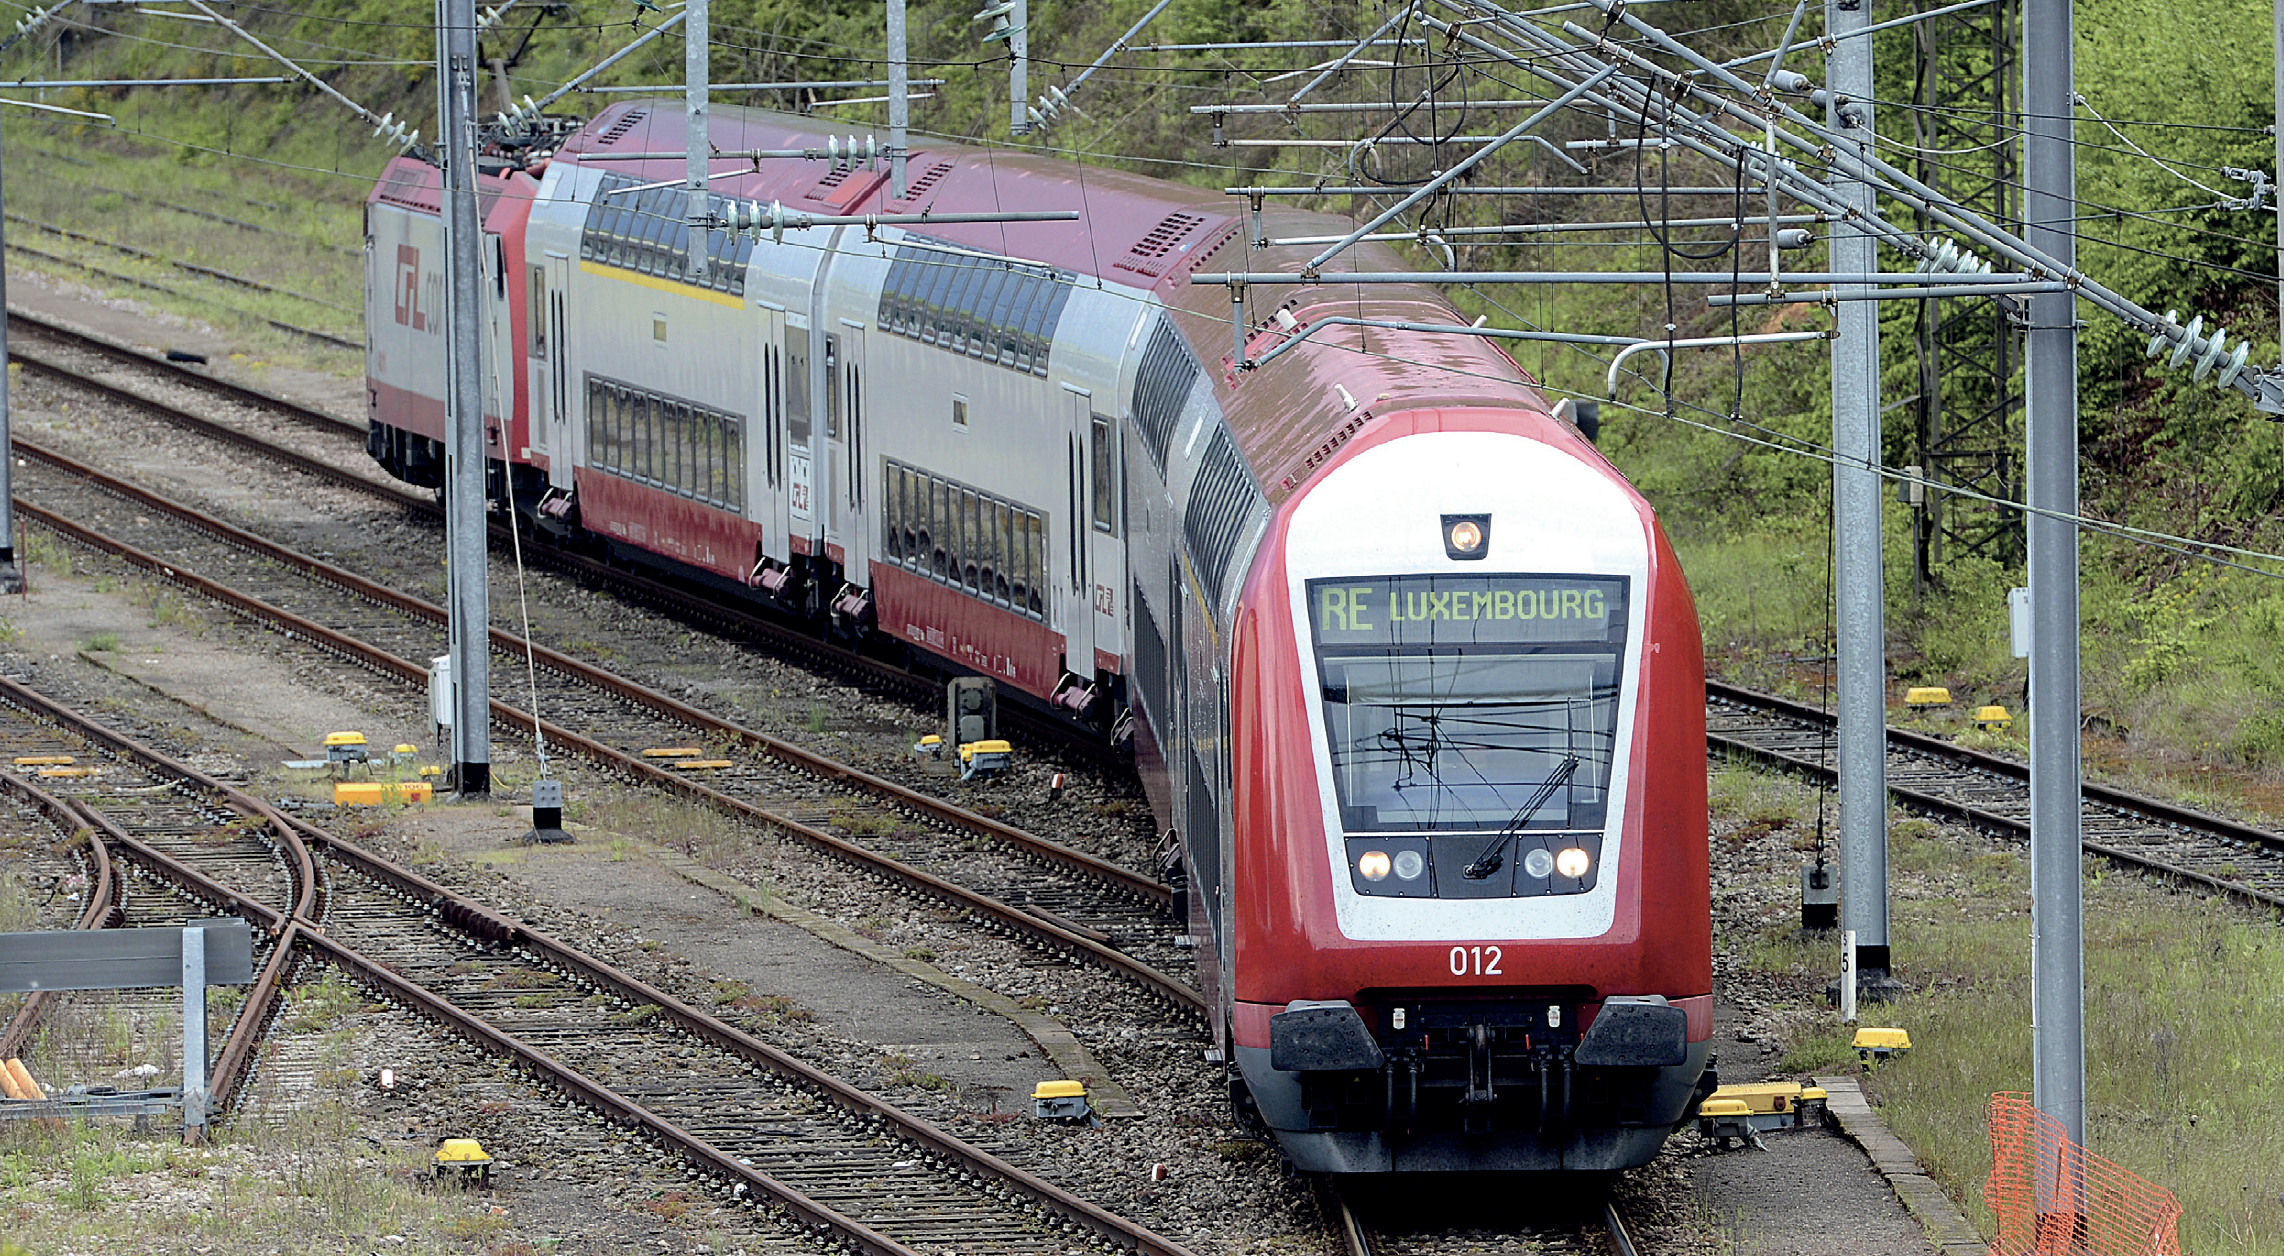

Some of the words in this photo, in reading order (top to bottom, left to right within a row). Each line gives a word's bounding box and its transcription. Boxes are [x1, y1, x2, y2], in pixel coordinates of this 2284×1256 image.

[395, 244, 425, 332] CFL
[1321, 587, 1373, 631] RE
[1389, 589, 1604, 621] LUXEMBOURG
[1450, 945, 1503, 975] 012
[1842, 952, 1849, 973] 5
